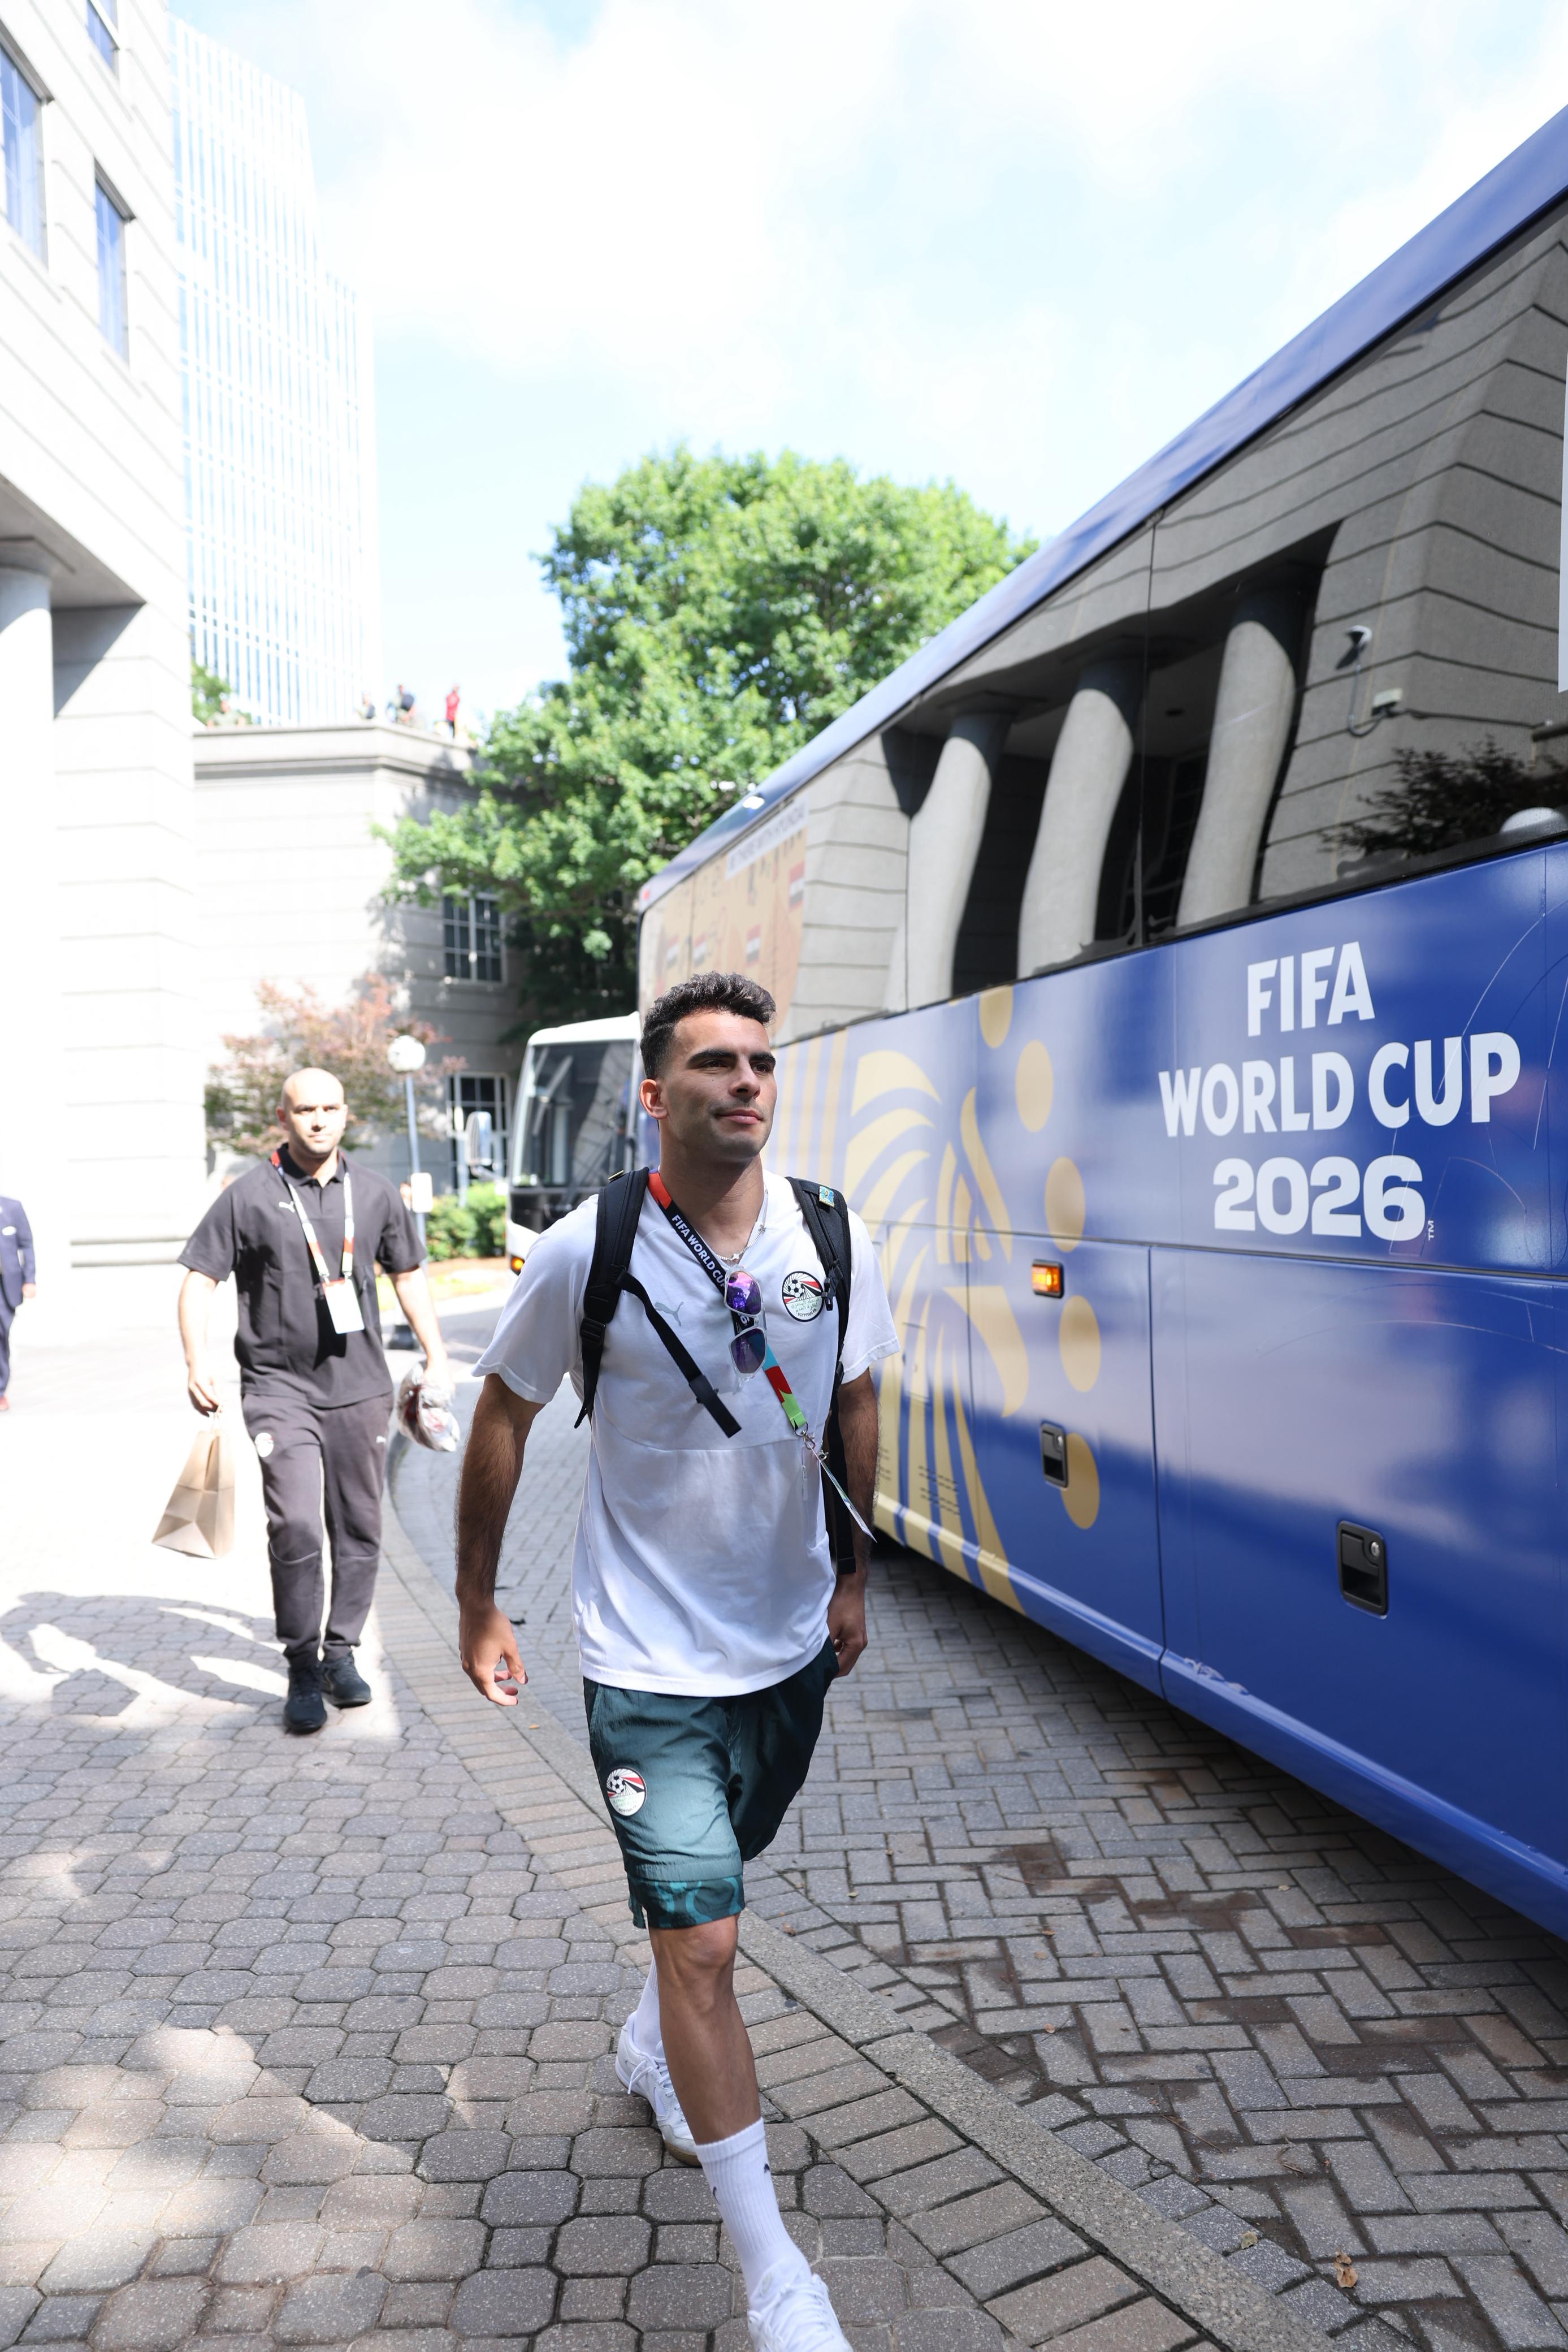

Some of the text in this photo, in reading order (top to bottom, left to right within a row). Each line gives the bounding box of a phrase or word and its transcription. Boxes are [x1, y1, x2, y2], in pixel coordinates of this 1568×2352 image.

[1248, 941, 1375, 1037] FIFA
[1158, 1032, 1521, 1138] WORLD CUP
[672, 1214, 691, 1238] FIFA
[687, 1234, 716, 1270] WORLD
[1213, 1155, 1426, 1242] 2026
